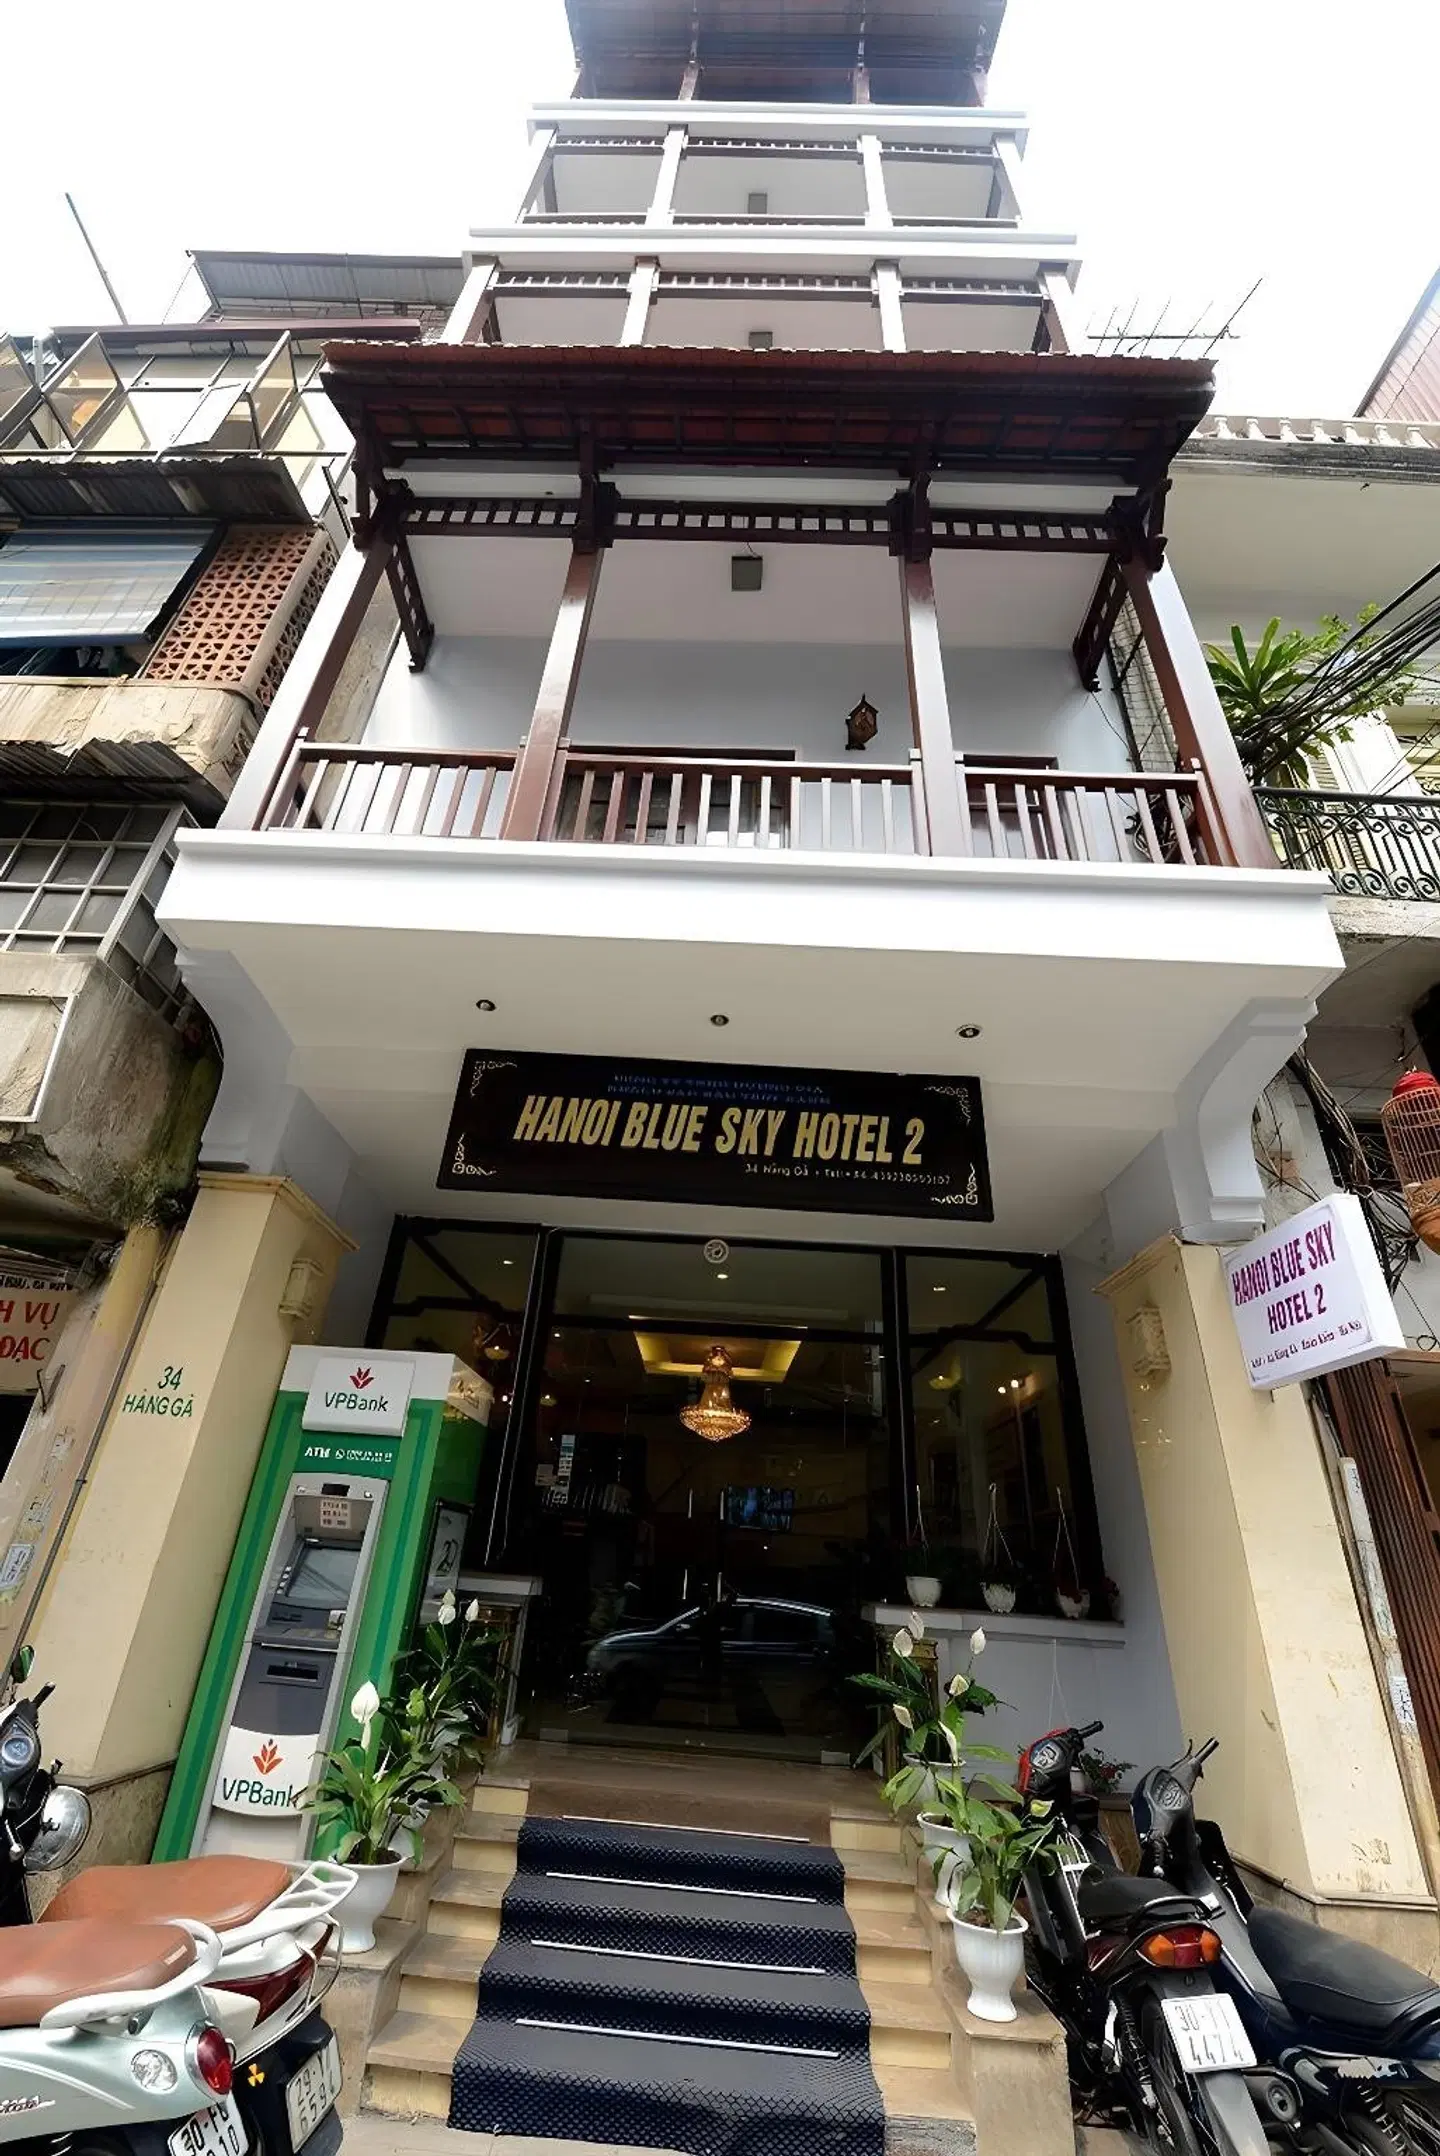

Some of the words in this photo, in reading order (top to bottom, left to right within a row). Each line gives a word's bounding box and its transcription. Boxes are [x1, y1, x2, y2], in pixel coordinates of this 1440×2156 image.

[513, 1094, 621, 1147] HANOI
[620, 1101, 708, 1153] BLUE
[715, 1106, 786, 1159] SKY
[792, 1111, 893, 1163] HOTEL
[903, 1117, 926, 1166] 2
[1231, 1256, 1271, 1306] HANOI
[1270, 1237, 1306, 1289] BLUE
[1305, 1220, 1337, 1271] SKY
[1267, 1290, 1313, 1334] HOTEL
[1314, 1283, 1327, 1315] 2
[157, 1366, 184, 1390] 34
[324, 1390, 389, 1412] VPBank
[222, 1777, 298, 1808] VPBank
